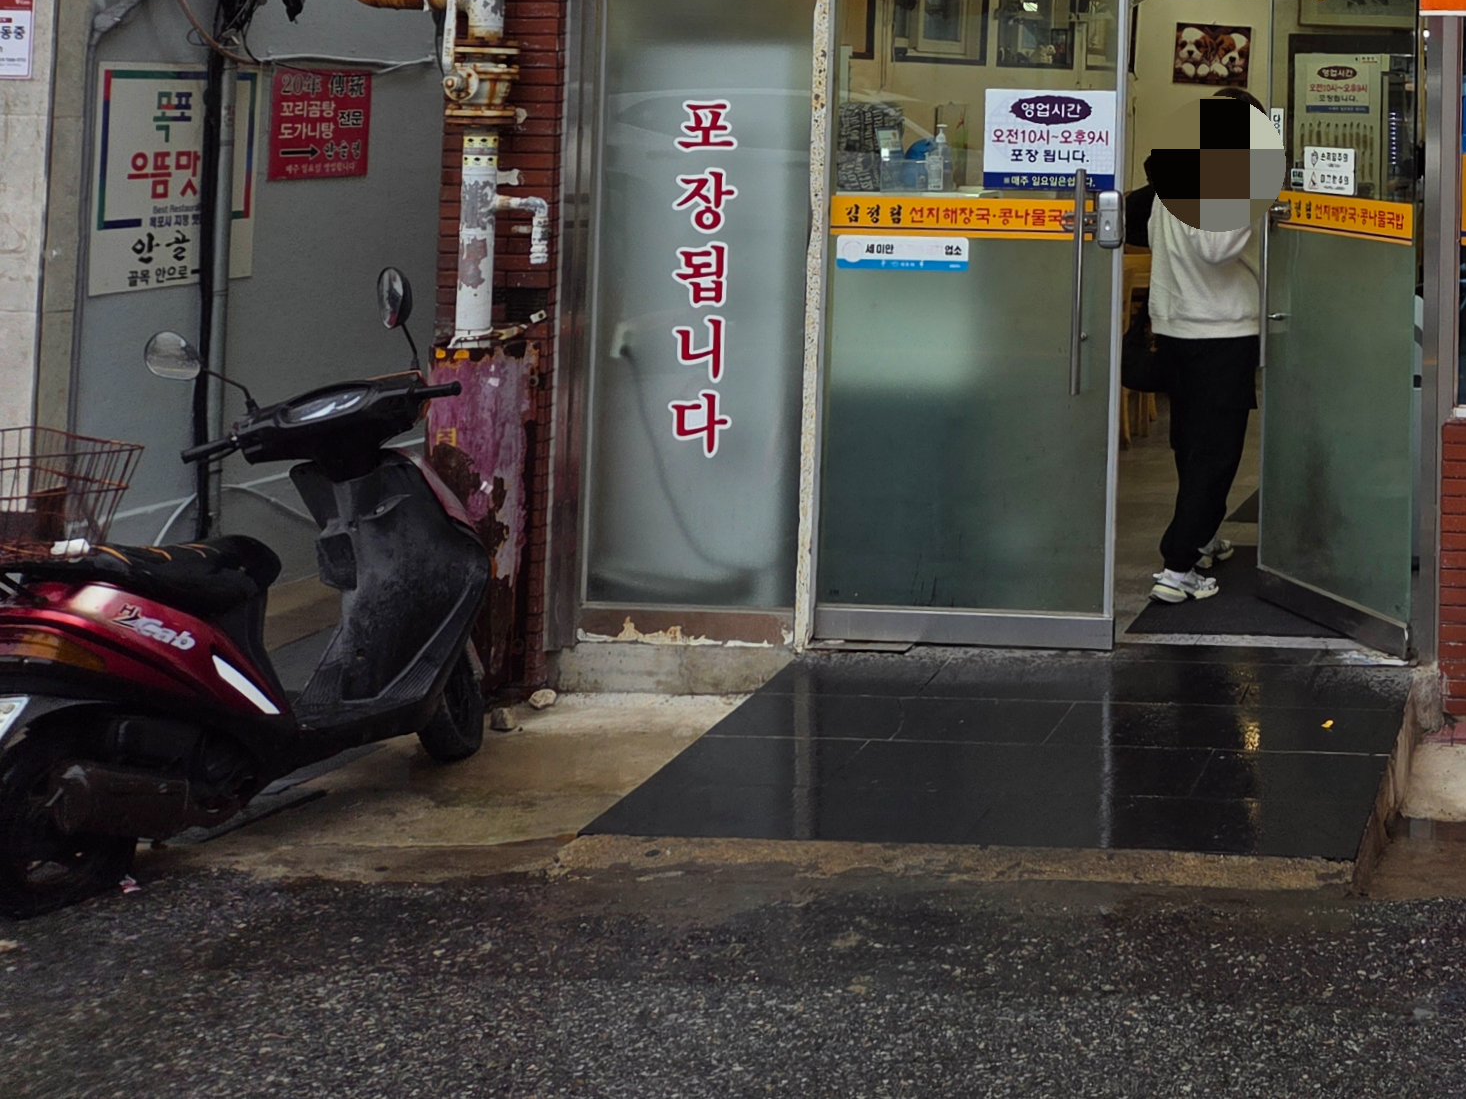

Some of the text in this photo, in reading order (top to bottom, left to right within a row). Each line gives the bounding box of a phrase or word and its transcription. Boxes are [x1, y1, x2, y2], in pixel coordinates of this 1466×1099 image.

[1321, 68, 1354, 78] 영업시간
[280, 101, 336, 118] 꼬리곰탕
[337, 109, 364, 127] 전문
[1021, 102, 1082, 118] 영업시간
[278, 122, 335, 139] 도가니탕
[991, 129, 1109, 146] 오전10시~오후9시
[1011, 149, 1090, 163] 포장 됩니다.
[127, 151, 201, 199] 으뜸맛
[170, 202, 201, 213] Restaura
[909, 206, 1076, 227] 선지해장국·콩나물국
[131, 229, 190, 264] 안골
[672, 102, 736, 456] 포장됩니다
